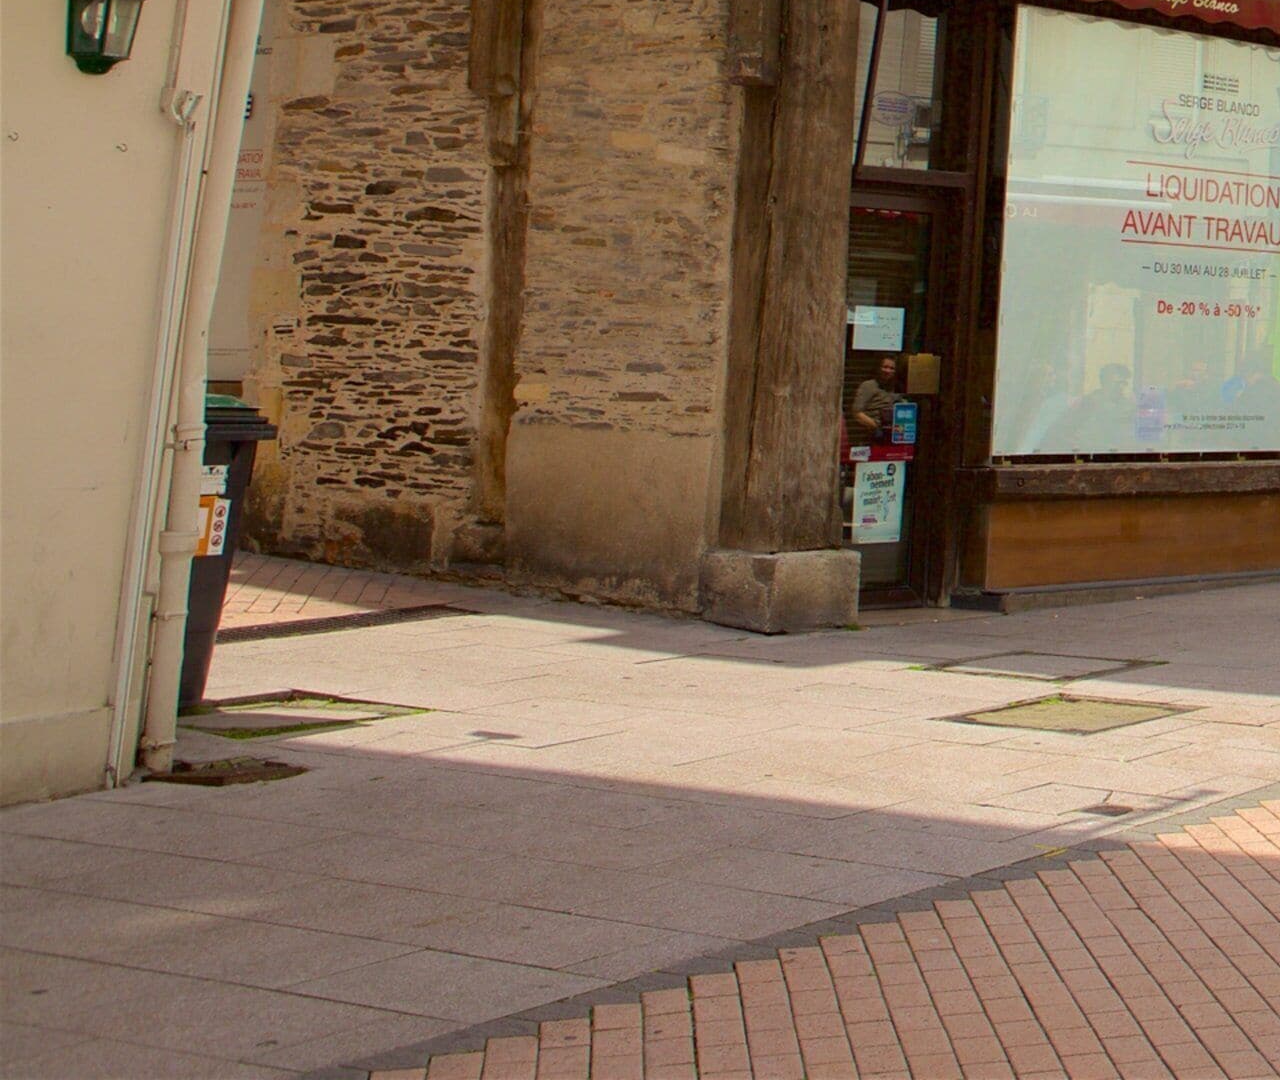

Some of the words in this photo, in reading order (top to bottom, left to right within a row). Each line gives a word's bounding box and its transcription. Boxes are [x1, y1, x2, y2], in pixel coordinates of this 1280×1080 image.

[1178, 93, 1214, 111] SERGE
[1216, 98, 1261, 118] BLANCO
[1146, 173, 1280, 209] LIQUIDATION
[1121, 210, 1197, 239] AVANT
[1154, 262, 1168, 274] DU
[1170, 263, 1182, 275] 30
[1184, 264, 1200, 276] MAI
[1203, 265, 1216, 277] AU
[1231, 268, 1267, 280] JUILLET
[1157, 300, 1173, 314] De
[1177, 301, 1195, 315] -20
[1199, 303, 1210, 316] %
[1213, 303, 1221, 316] à
[1224, 304, 1241, 317] -50
